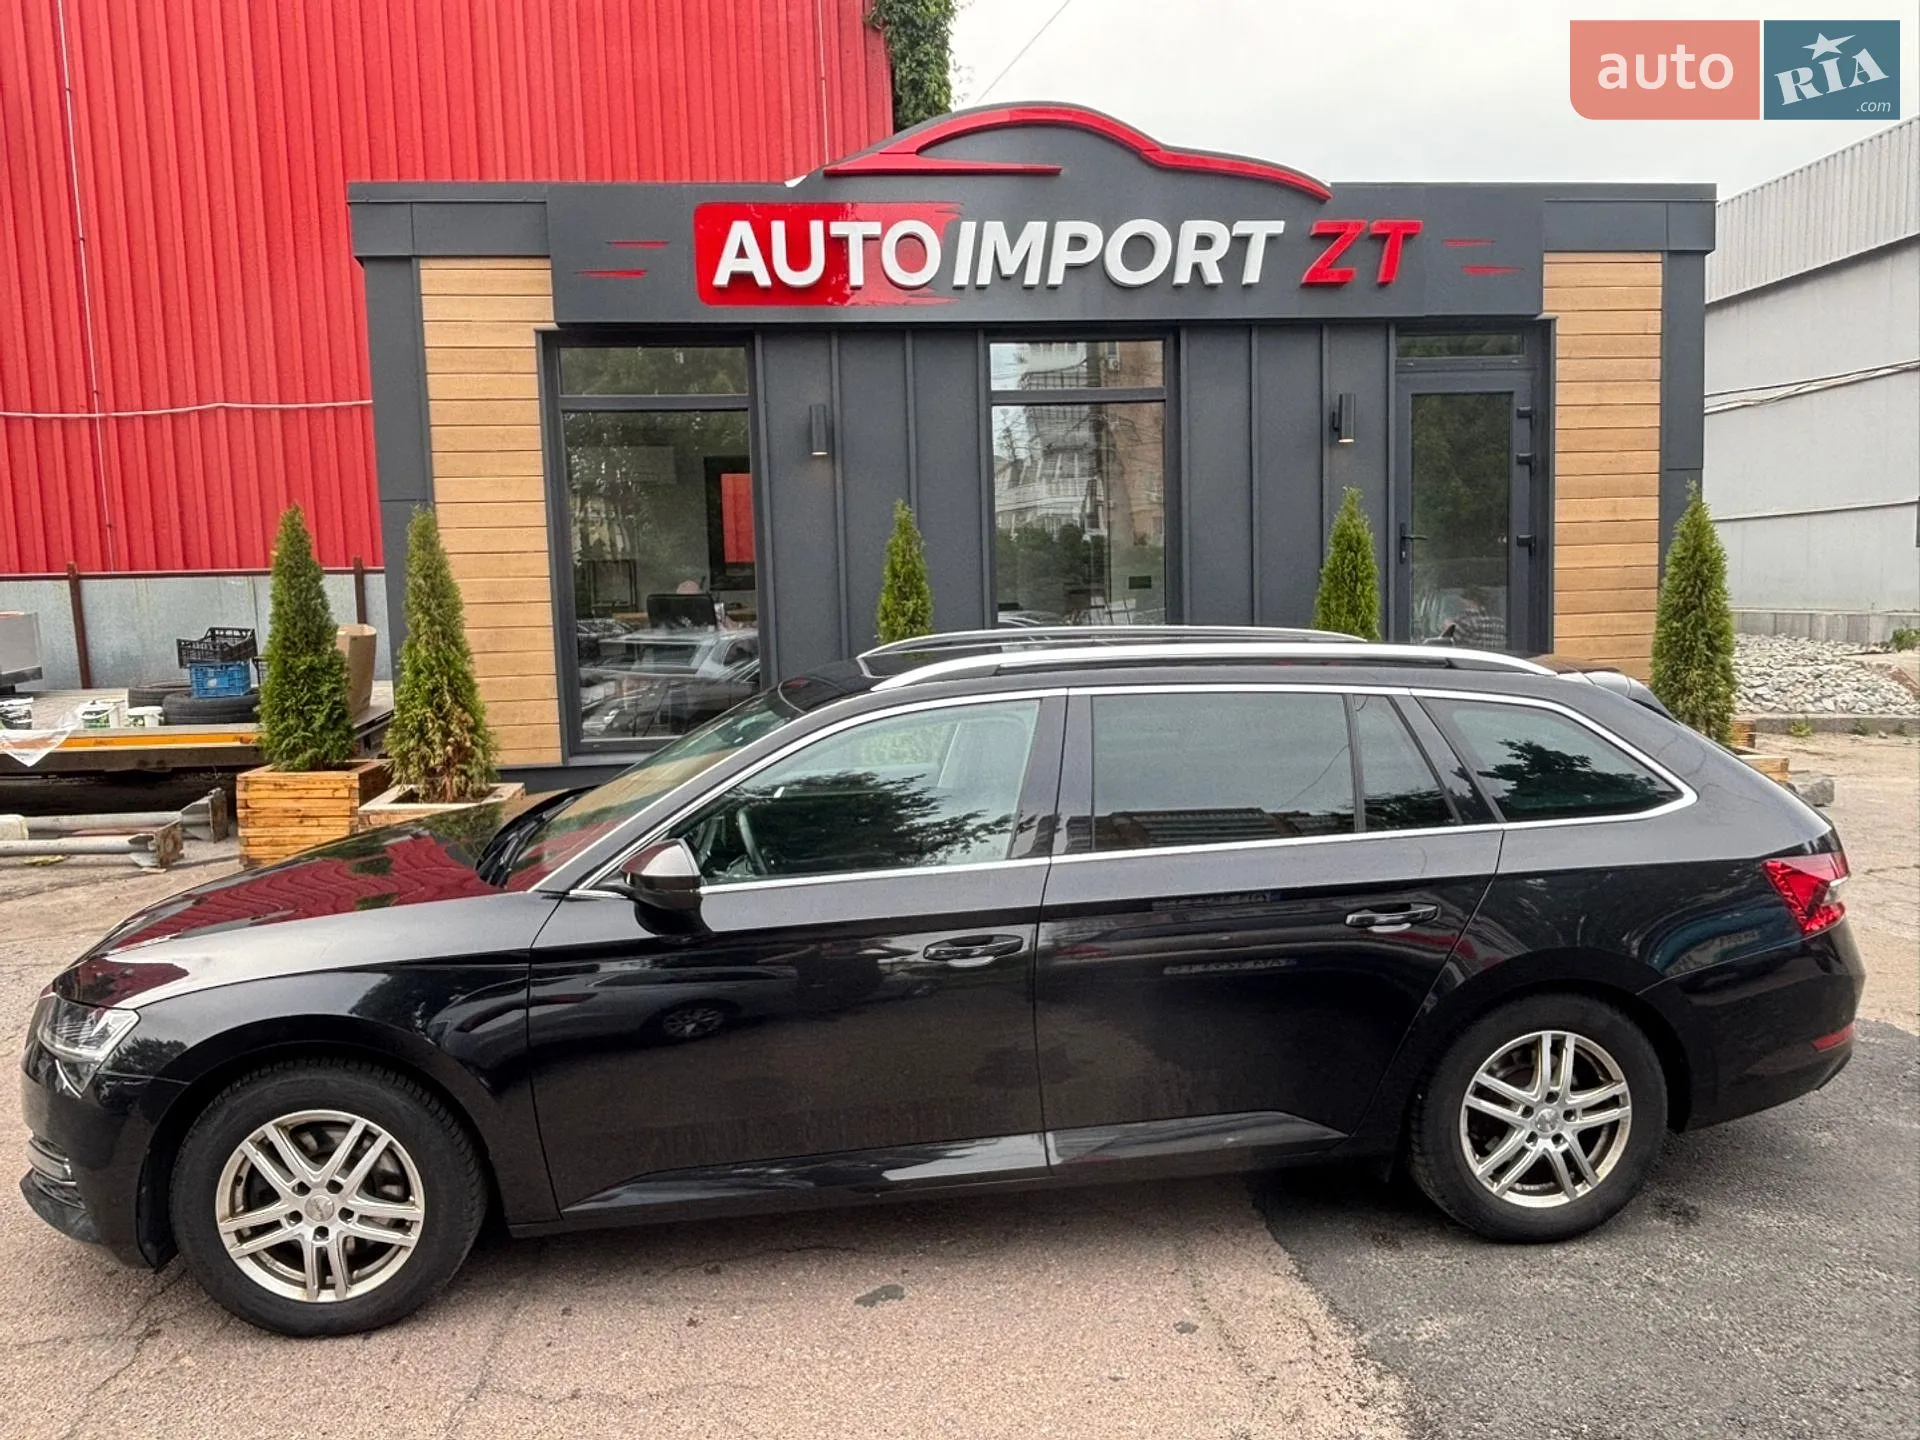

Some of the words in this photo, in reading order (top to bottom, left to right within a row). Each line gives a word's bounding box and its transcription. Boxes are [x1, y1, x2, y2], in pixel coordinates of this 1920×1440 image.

[712, 219, 942, 288] AUTO
[951, 218, 1285, 289] IMPORT
[1302, 219, 1423, 286] ZT
